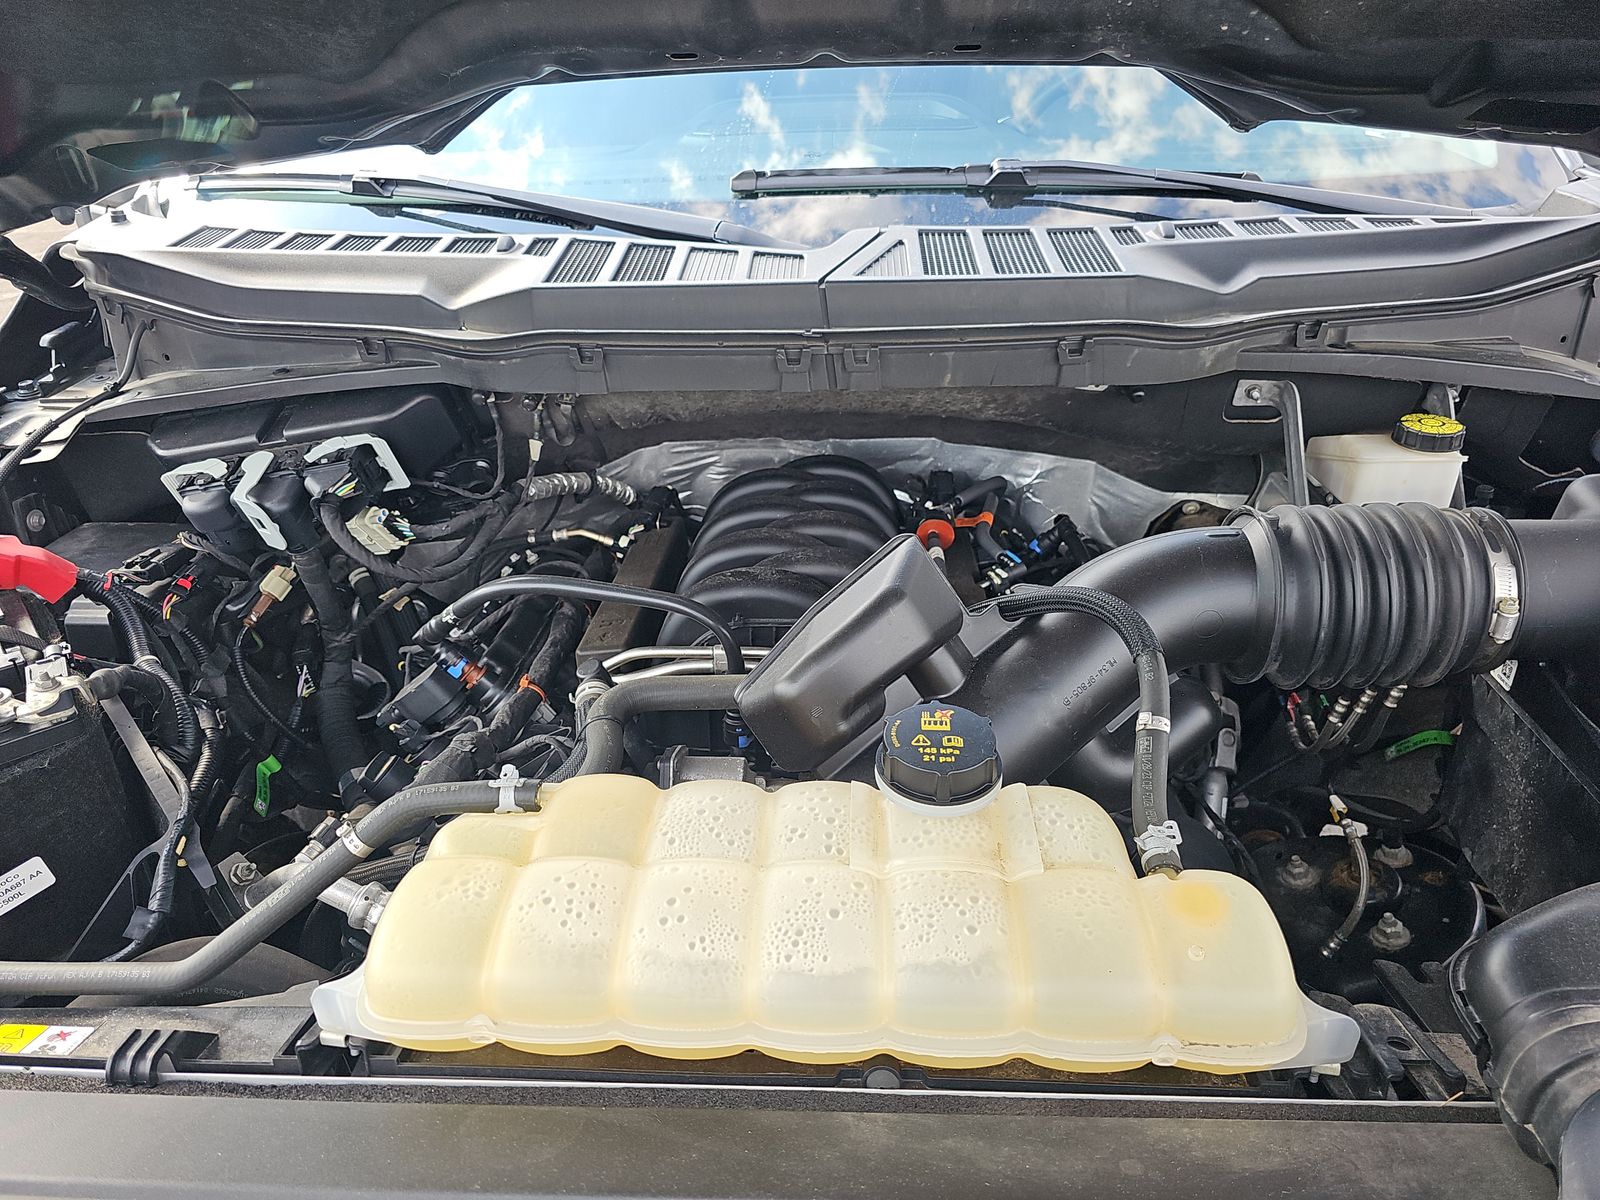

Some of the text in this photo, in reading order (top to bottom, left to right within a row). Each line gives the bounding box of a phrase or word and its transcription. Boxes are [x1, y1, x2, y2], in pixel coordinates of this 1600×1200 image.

[940, 747, 960, 755] kPa
[939, 755, 955, 763] psi
[29, 870, 43, 881] AA
[0, 874, 20, 888] oCo
